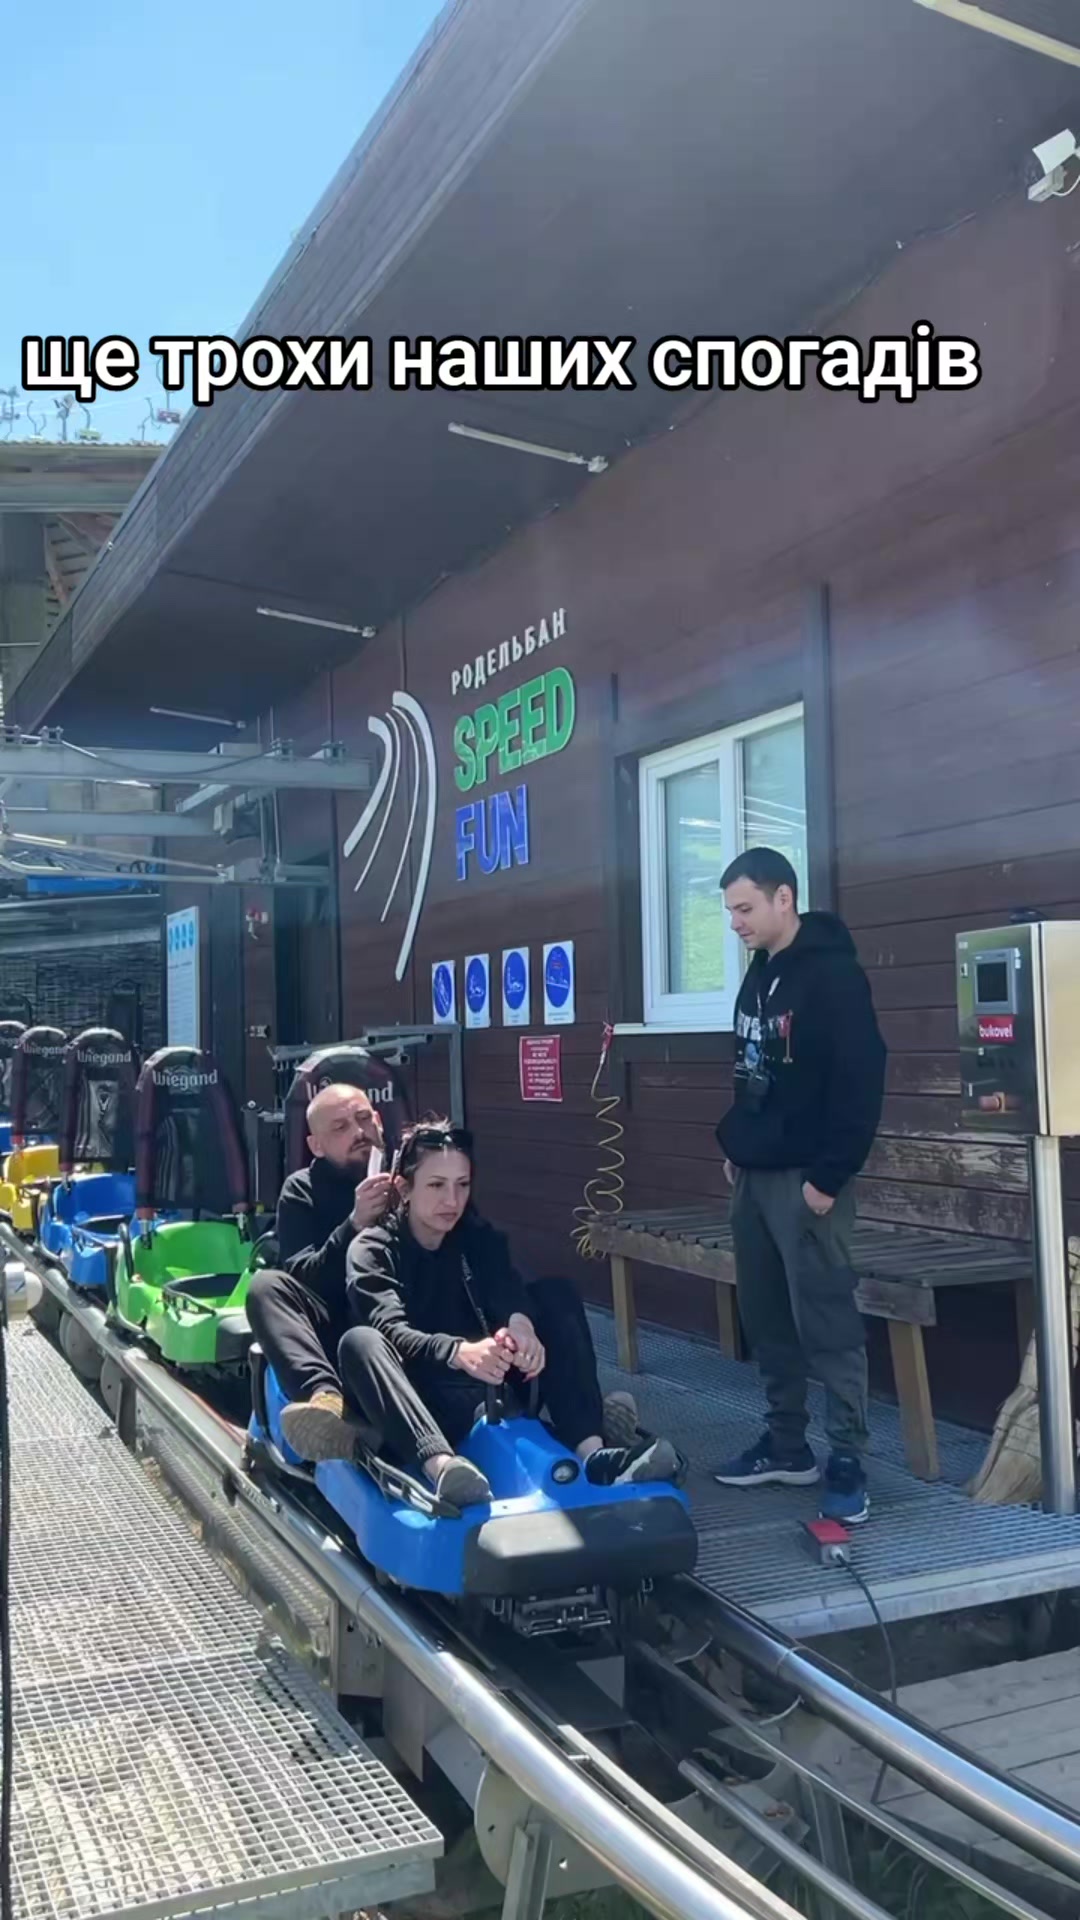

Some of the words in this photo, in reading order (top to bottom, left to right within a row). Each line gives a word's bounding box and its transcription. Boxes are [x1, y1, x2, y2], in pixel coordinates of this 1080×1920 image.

[451, 608, 567, 696] РОДЕЛЬБАН
[454, 667, 575, 792] SPEED
[456, 784, 529, 881] FUN
[77, 1049, 131, 1067] Wiegand
[979, 1023, 1013, 1038] bukovel
[152, 1069, 218, 1091] Wiegand
